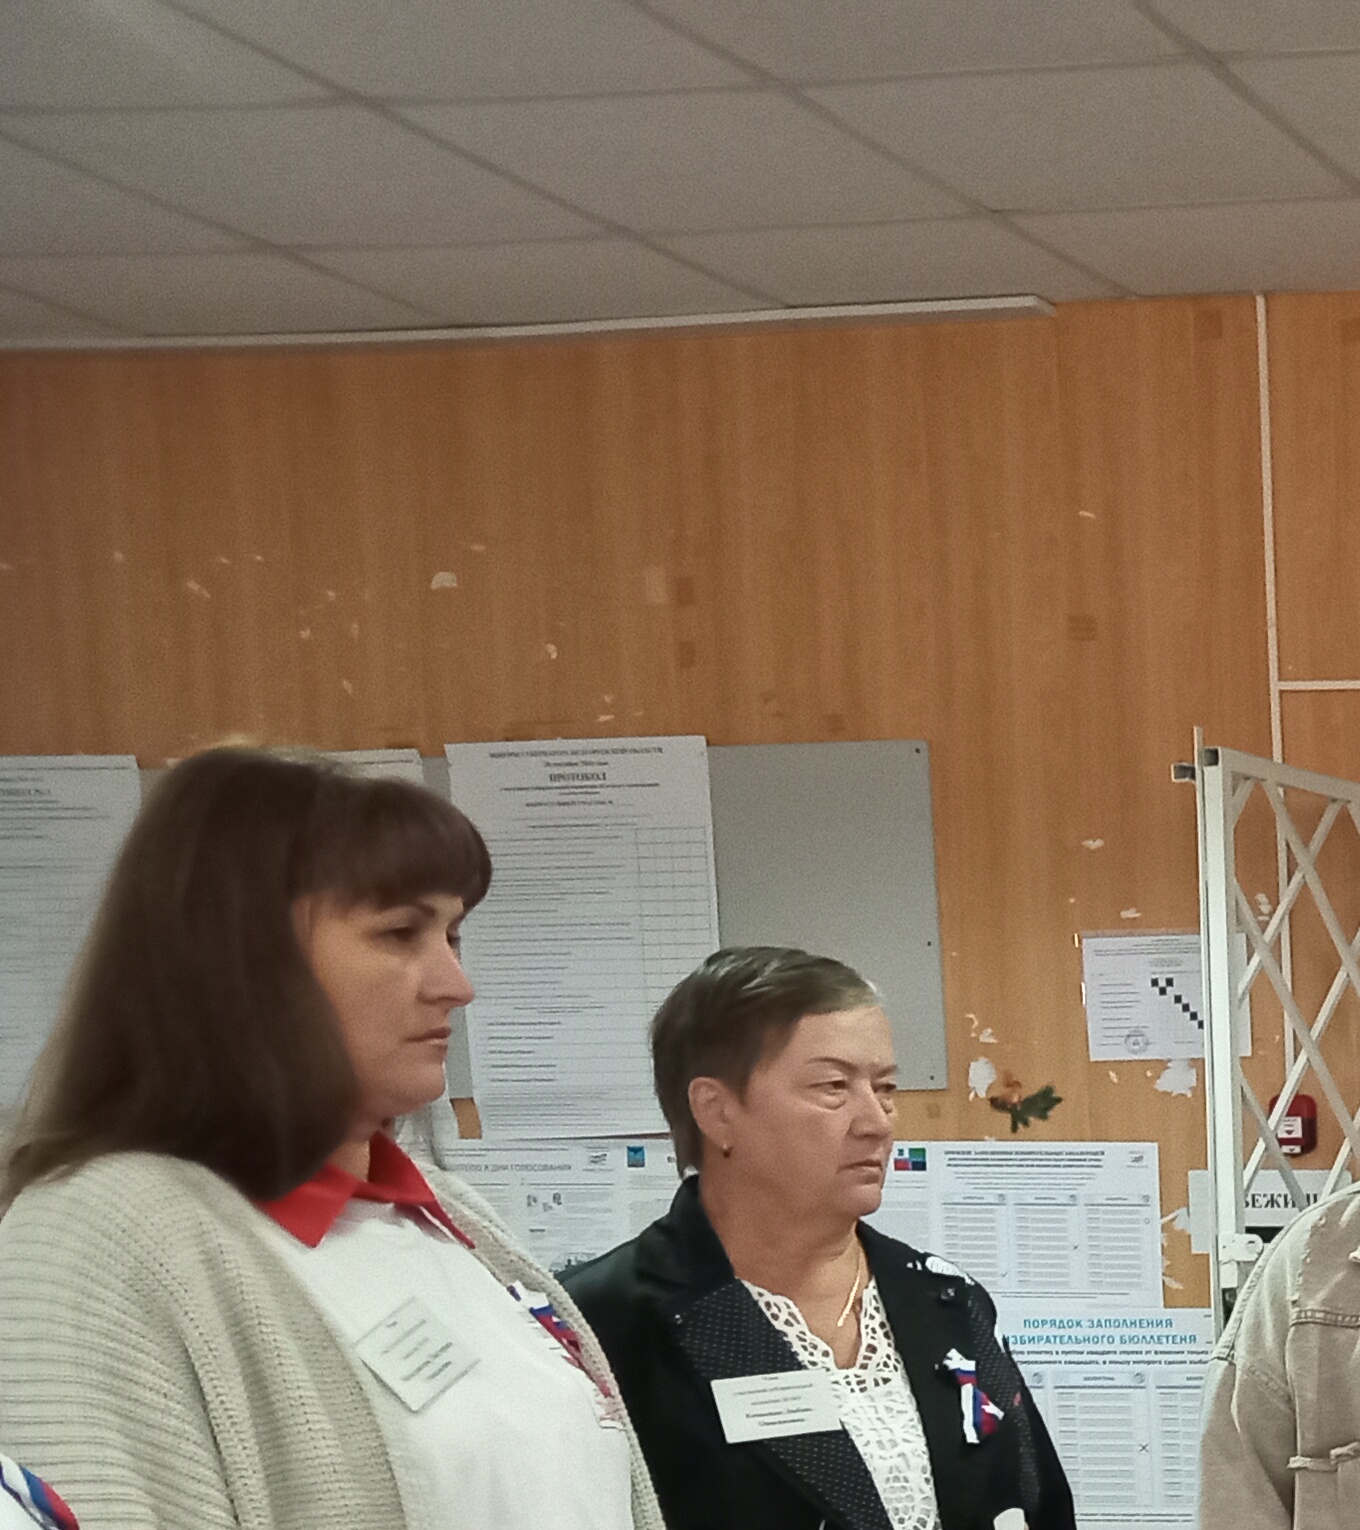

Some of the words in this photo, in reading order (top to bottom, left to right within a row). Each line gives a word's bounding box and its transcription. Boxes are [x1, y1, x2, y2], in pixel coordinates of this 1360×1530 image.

[1023, 1318, 1082, 1329] ПОРЯДОК
[1087, 1318, 1173, 1329] ЗАПОЛНЕНИЯ
[1120, 1334, 1197, 1345] БЮЛЛЕТЕНЯ
